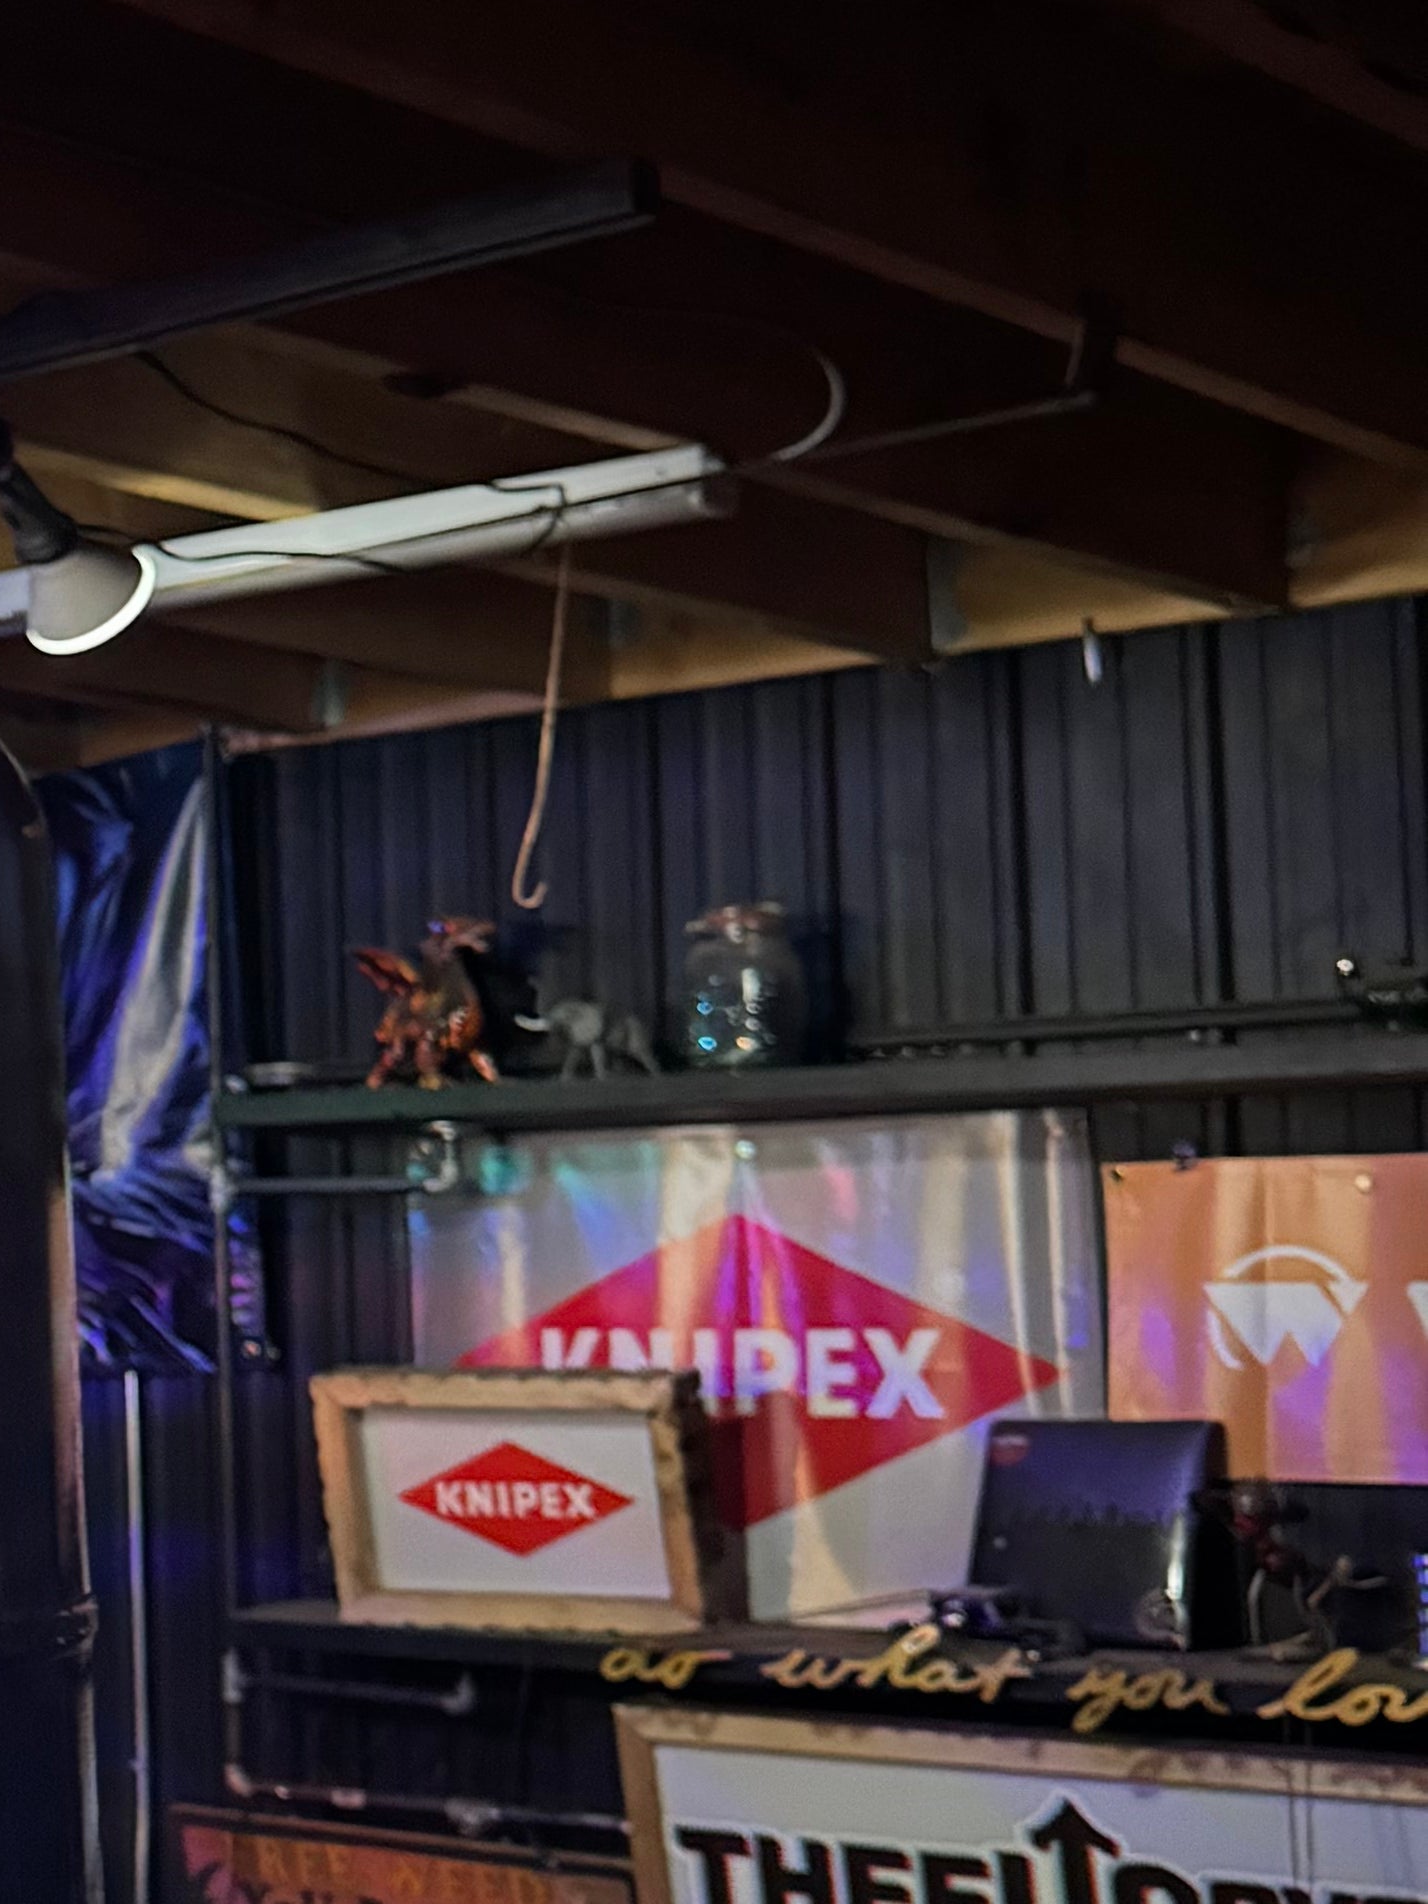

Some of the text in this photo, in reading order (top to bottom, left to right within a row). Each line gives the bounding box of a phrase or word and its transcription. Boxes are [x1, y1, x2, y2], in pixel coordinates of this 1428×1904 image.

[434, 1480, 597, 1520] KNIPEX
[759, 1622, 1033, 1704] what
[1065, 1666, 1231, 1734] you
